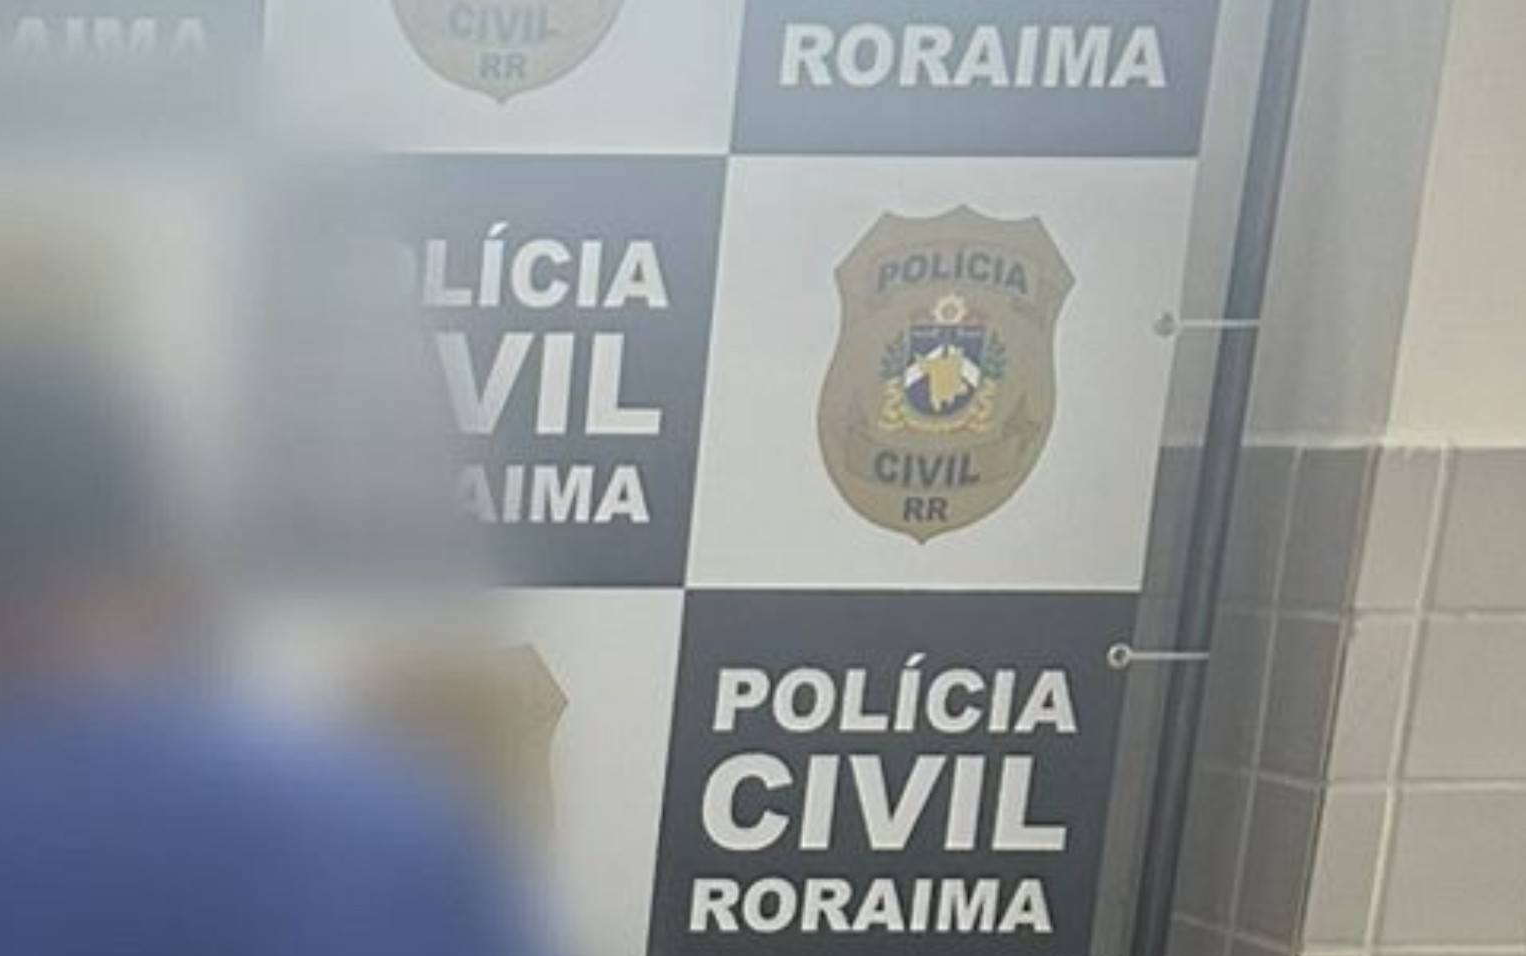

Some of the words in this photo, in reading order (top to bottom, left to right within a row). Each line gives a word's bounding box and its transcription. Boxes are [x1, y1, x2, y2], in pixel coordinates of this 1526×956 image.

[480, 52, 527, 80] RR
[779, 22, 1167, 88] RORAIMA
[395, 221, 670, 308] LÍCIA
[877, 251, 1029, 295] POLÍCIA
[874, 451, 981, 488] CIVIL
[903, 496, 949, 522] RR
[711, 652, 1078, 734] POLÍCIA
[701, 753, 1067, 852] CIVIL
[688, 877, 1054, 932] RORAIMA
